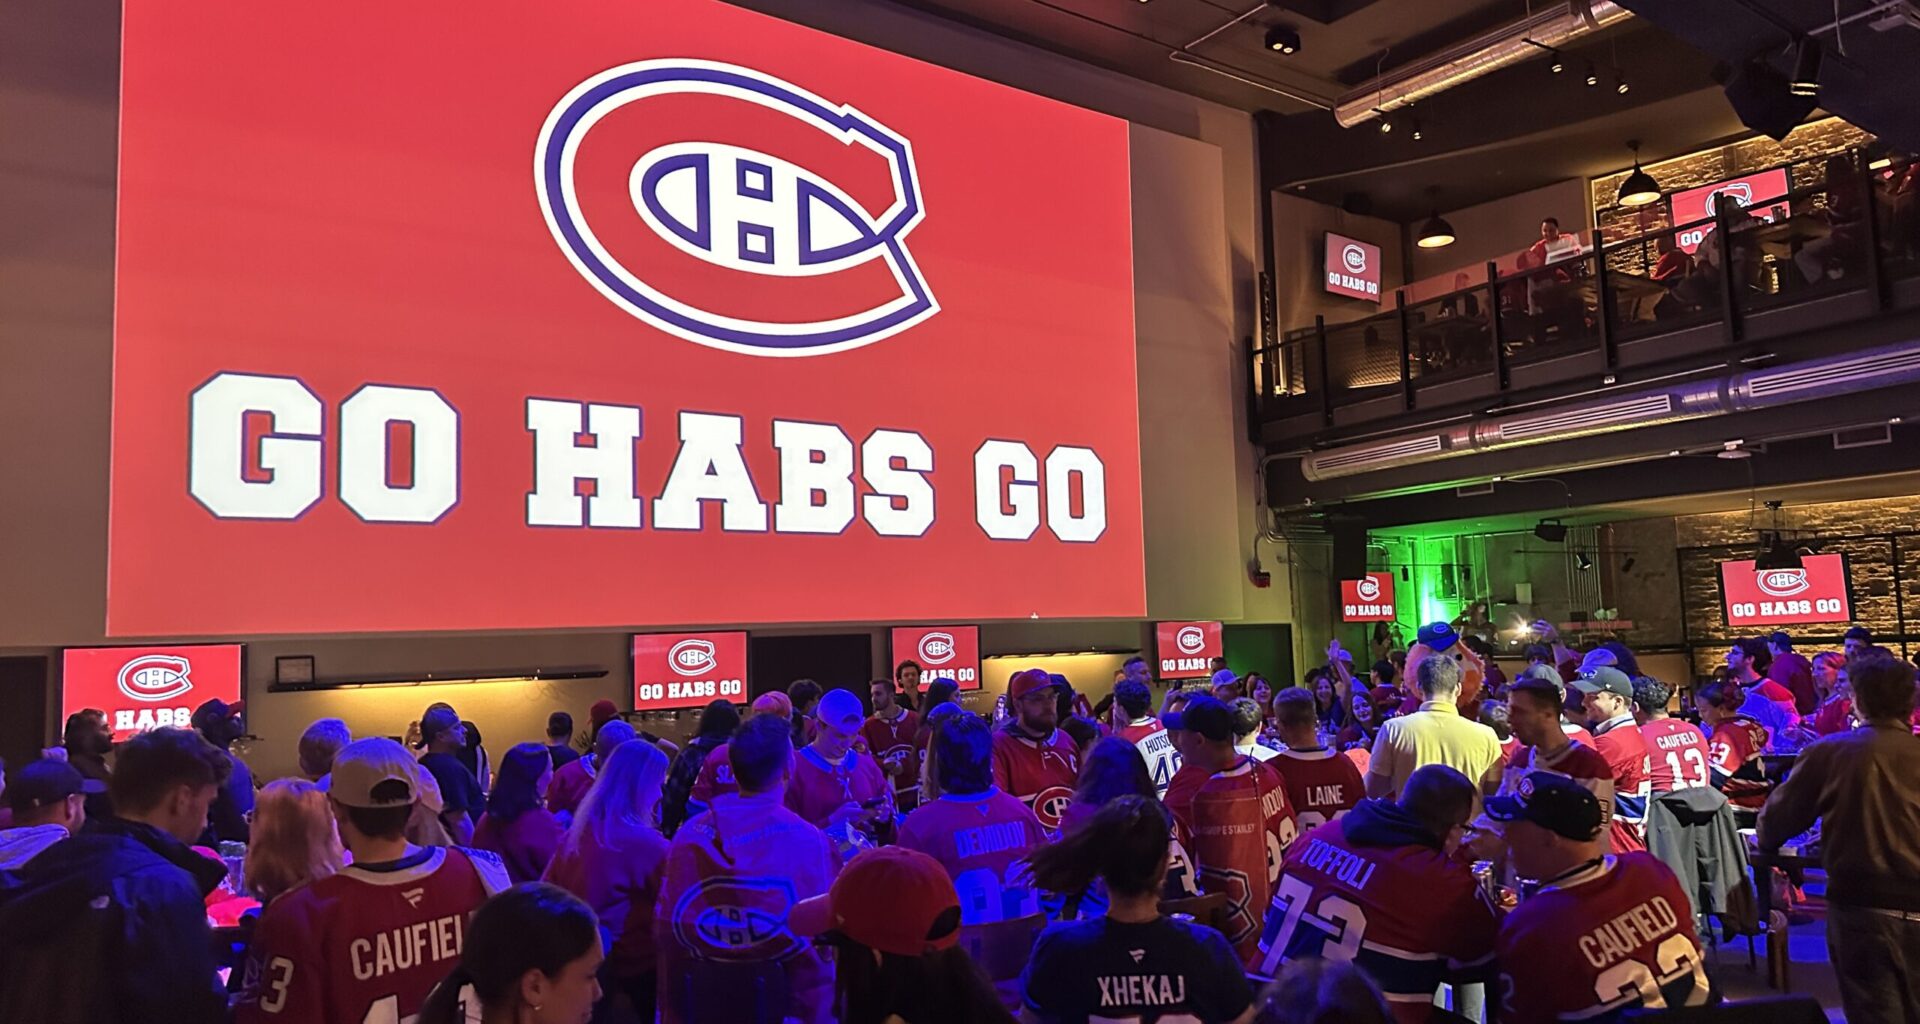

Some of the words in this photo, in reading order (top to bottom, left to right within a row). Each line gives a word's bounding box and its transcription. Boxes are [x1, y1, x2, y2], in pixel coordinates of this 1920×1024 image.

[1680, 231, 1704, 248] GO
[1328, 272, 1341, 286] GO
[1342, 275, 1366, 292] HABS
[1366, 281, 1378, 295] GO
[187, 370, 462, 525] GO
[524, 395, 937, 539] HABS
[972, 437, 1109, 544] GO
[1345, 604, 1357, 617] GO
[1357, 604, 1381, 617] HABS
[1381, 604, 1393, 617] GO
[1732, 602, 1757, 618] GO
[1760, 599, 1812, 616] HABS
[1816, 598, 1842, 613] GO
[958, 667, 975, 682] GO
[1162, 659, 1176, 672] GO
[1177, 658, 1205, 671] HABS
[640, 683, 664, 701] GO
[667, 680, 716, 699] HABS
[719, 679, 742, 696] GO
[115, 706, 191, 731] HABS
[1656, 731, 1699, 750] CAUFIELD
[1666, 747, 1708, 792] 13
[1306, 784, 1345, 807] LAINE
[953, 821, 1027, 860] DEMIDOV
[1300, 837, 1377, 891] TOFFOLI
[1578, 895, 1679, 969] CAUFIELD
[350, 910, 474, 981] CAUFIEL
[1096, 973, 1186, 1007] XHEKAJ
